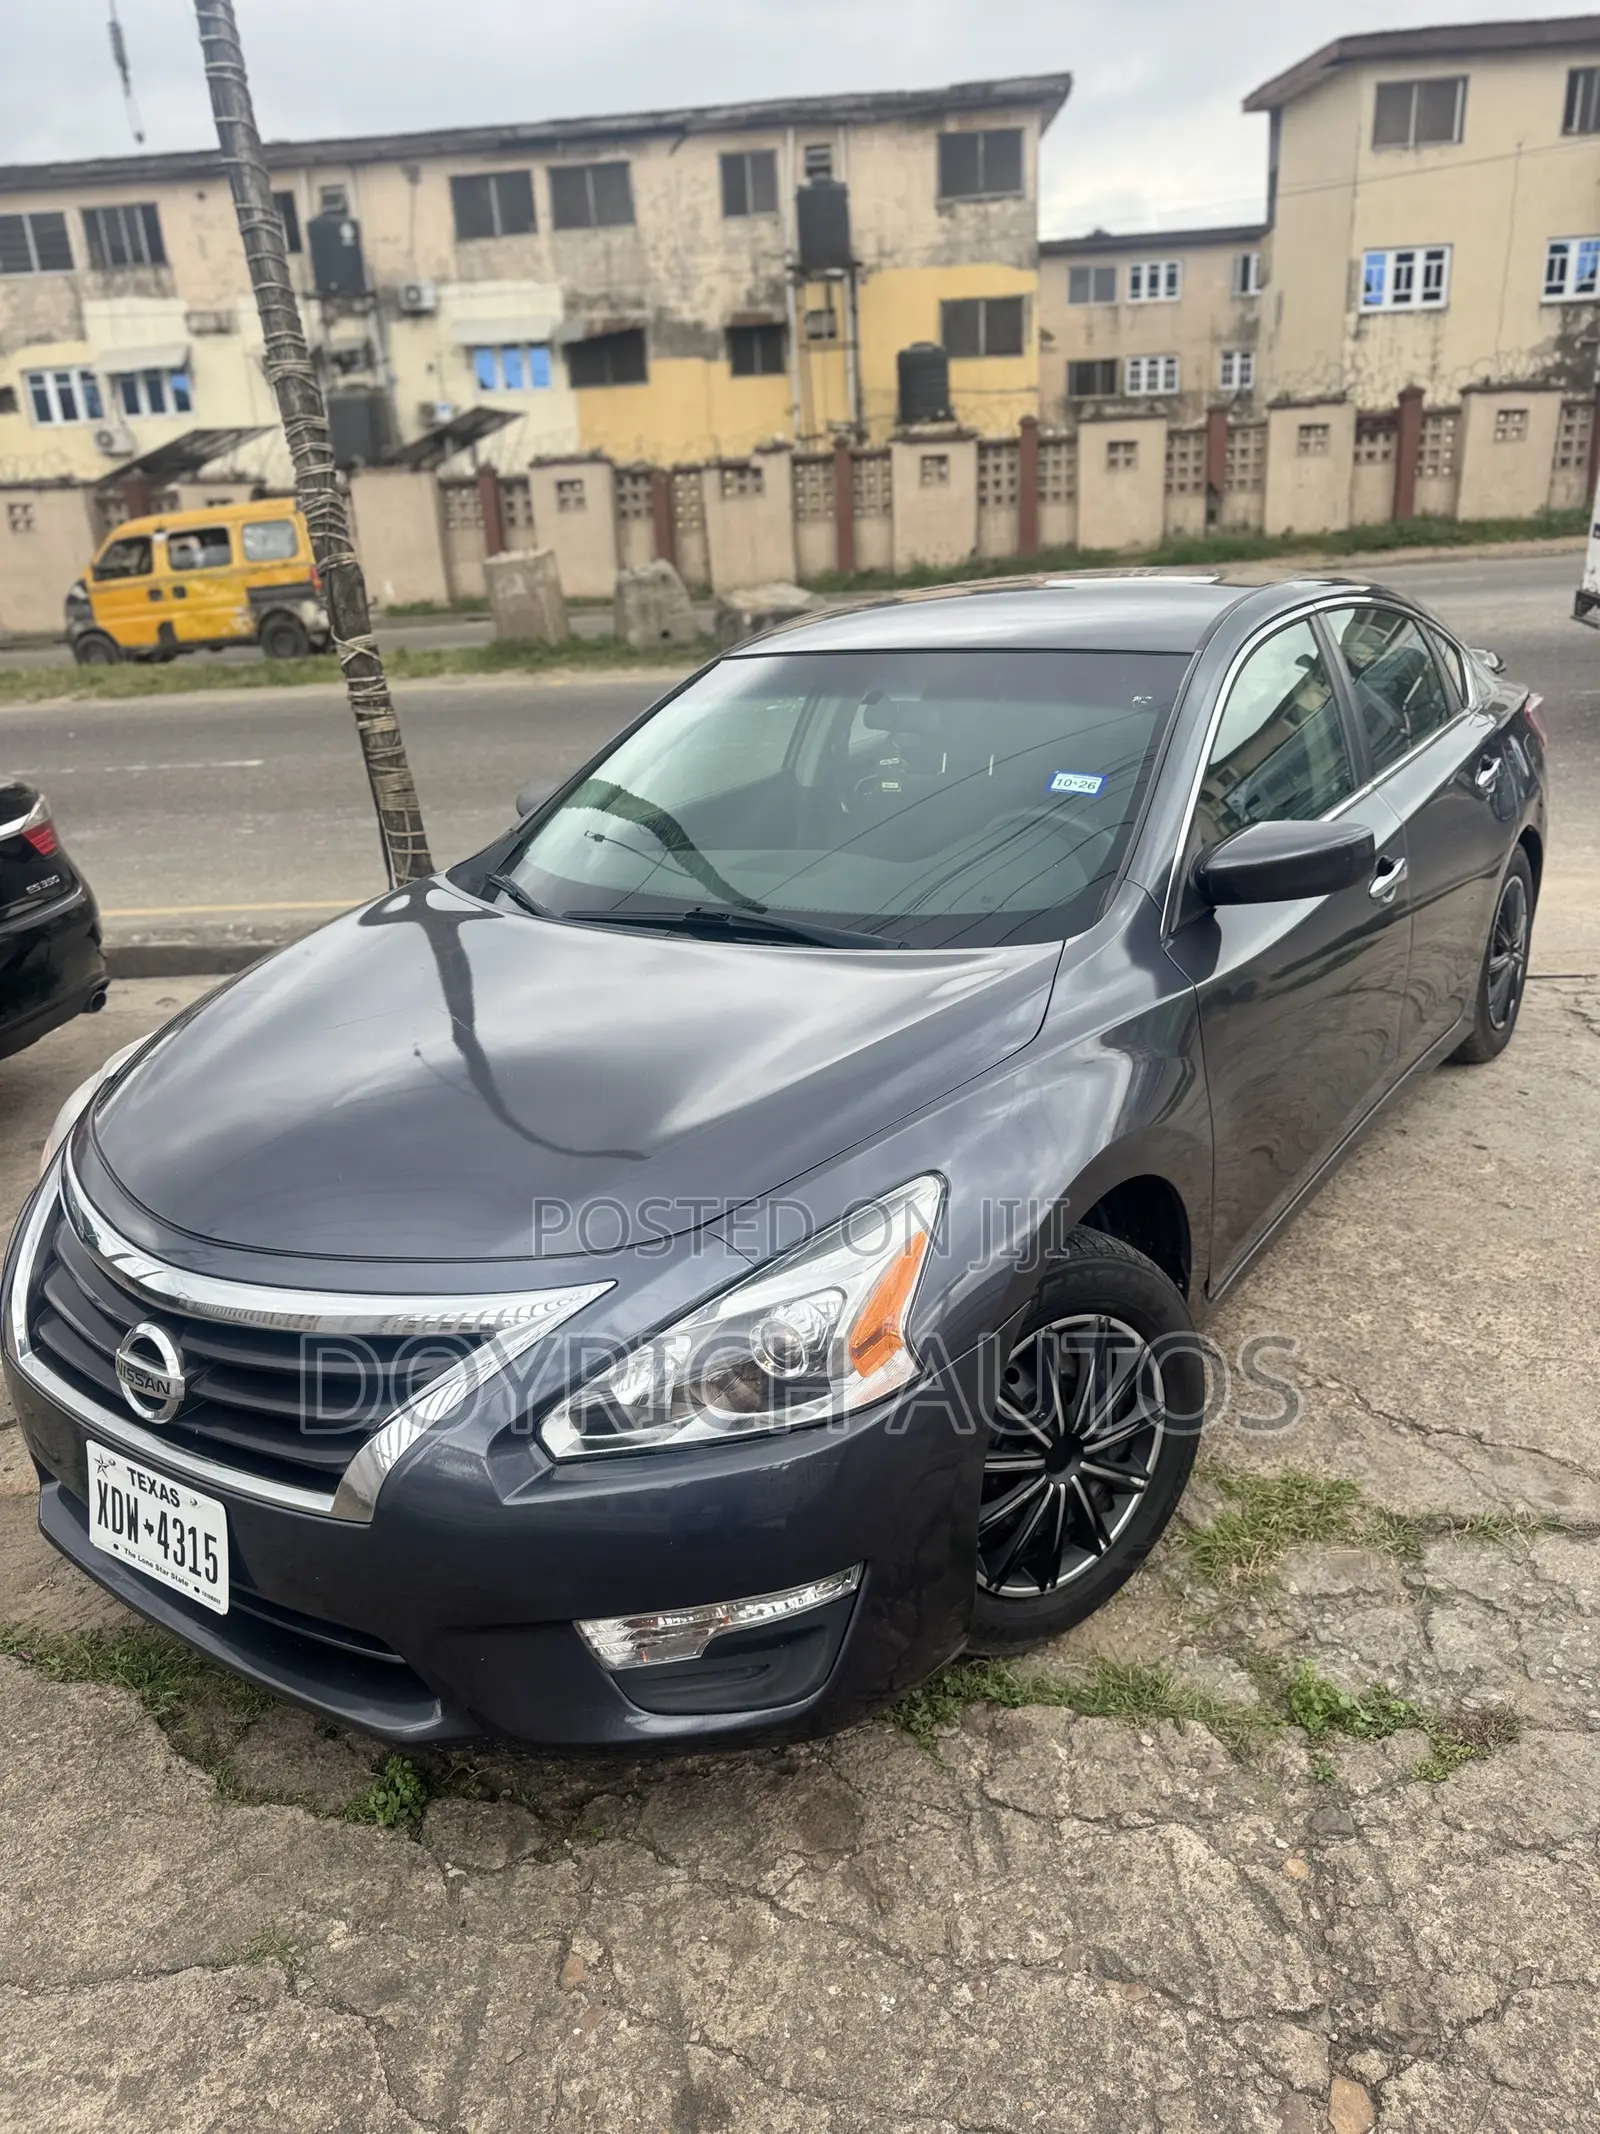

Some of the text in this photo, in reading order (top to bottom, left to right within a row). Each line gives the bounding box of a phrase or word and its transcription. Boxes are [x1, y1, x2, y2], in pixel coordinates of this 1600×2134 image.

[117, 1358, 171, 1396] NISSAN
[126, 1466, 180, 1508] TEXAS
[123, 1547, 189, 1587] The Lone Star State
